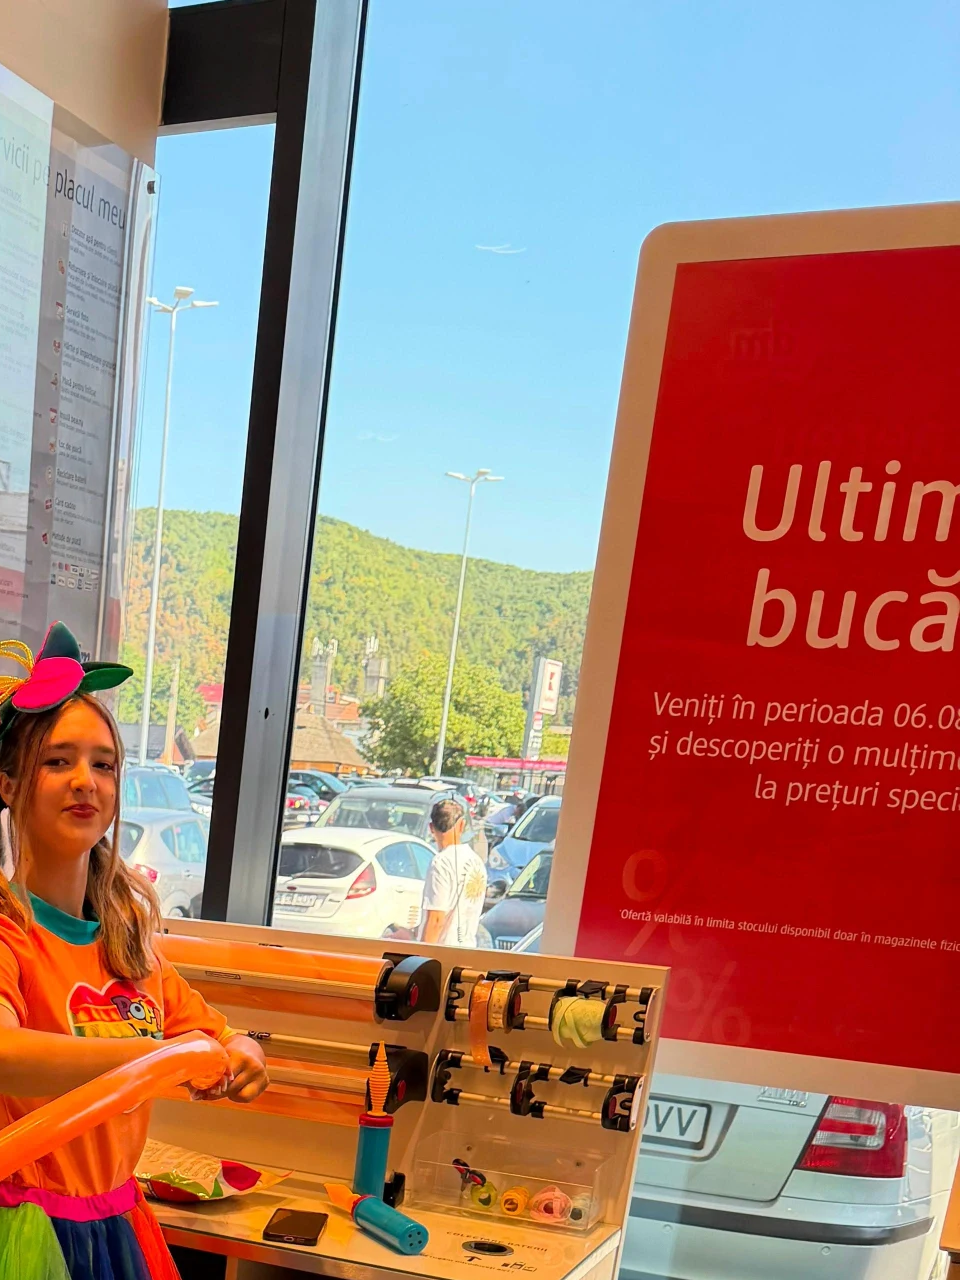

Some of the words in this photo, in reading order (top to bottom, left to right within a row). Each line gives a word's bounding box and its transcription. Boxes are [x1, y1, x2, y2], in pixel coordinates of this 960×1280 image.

[33, 158, 51, 186] pe
[55, 168, 94, 212] placul
[99, 196, 125, 230] meu
[746, 567, 960, 653] bucă
[652, 692, 725, 726] Veniți
[732, 693, 755, 720] în
[764, 698, 884, 727] perioada
[648, 731, 669, 761] și
[676, 731, 820, 769] descoperiți
[828, 745, 844, 764] o
[854, 742, 960, 776] mulțim
[755, 774, 777, 800] la
[786, 779, 880, 810] prețuri
[887, 781, 960, 814] speci
[654, 912, 691, 925] valabilă
[694, 915, 704, 927] în
[706, 917, 735, 930] limita
[738, 920, 778, 933] stocului
[781, 924, 830, 939] disponibil
[834, 929, 858, 942] doar
[861, 931, 871, 943] în
[874, 934, 937, 950] magazinele
